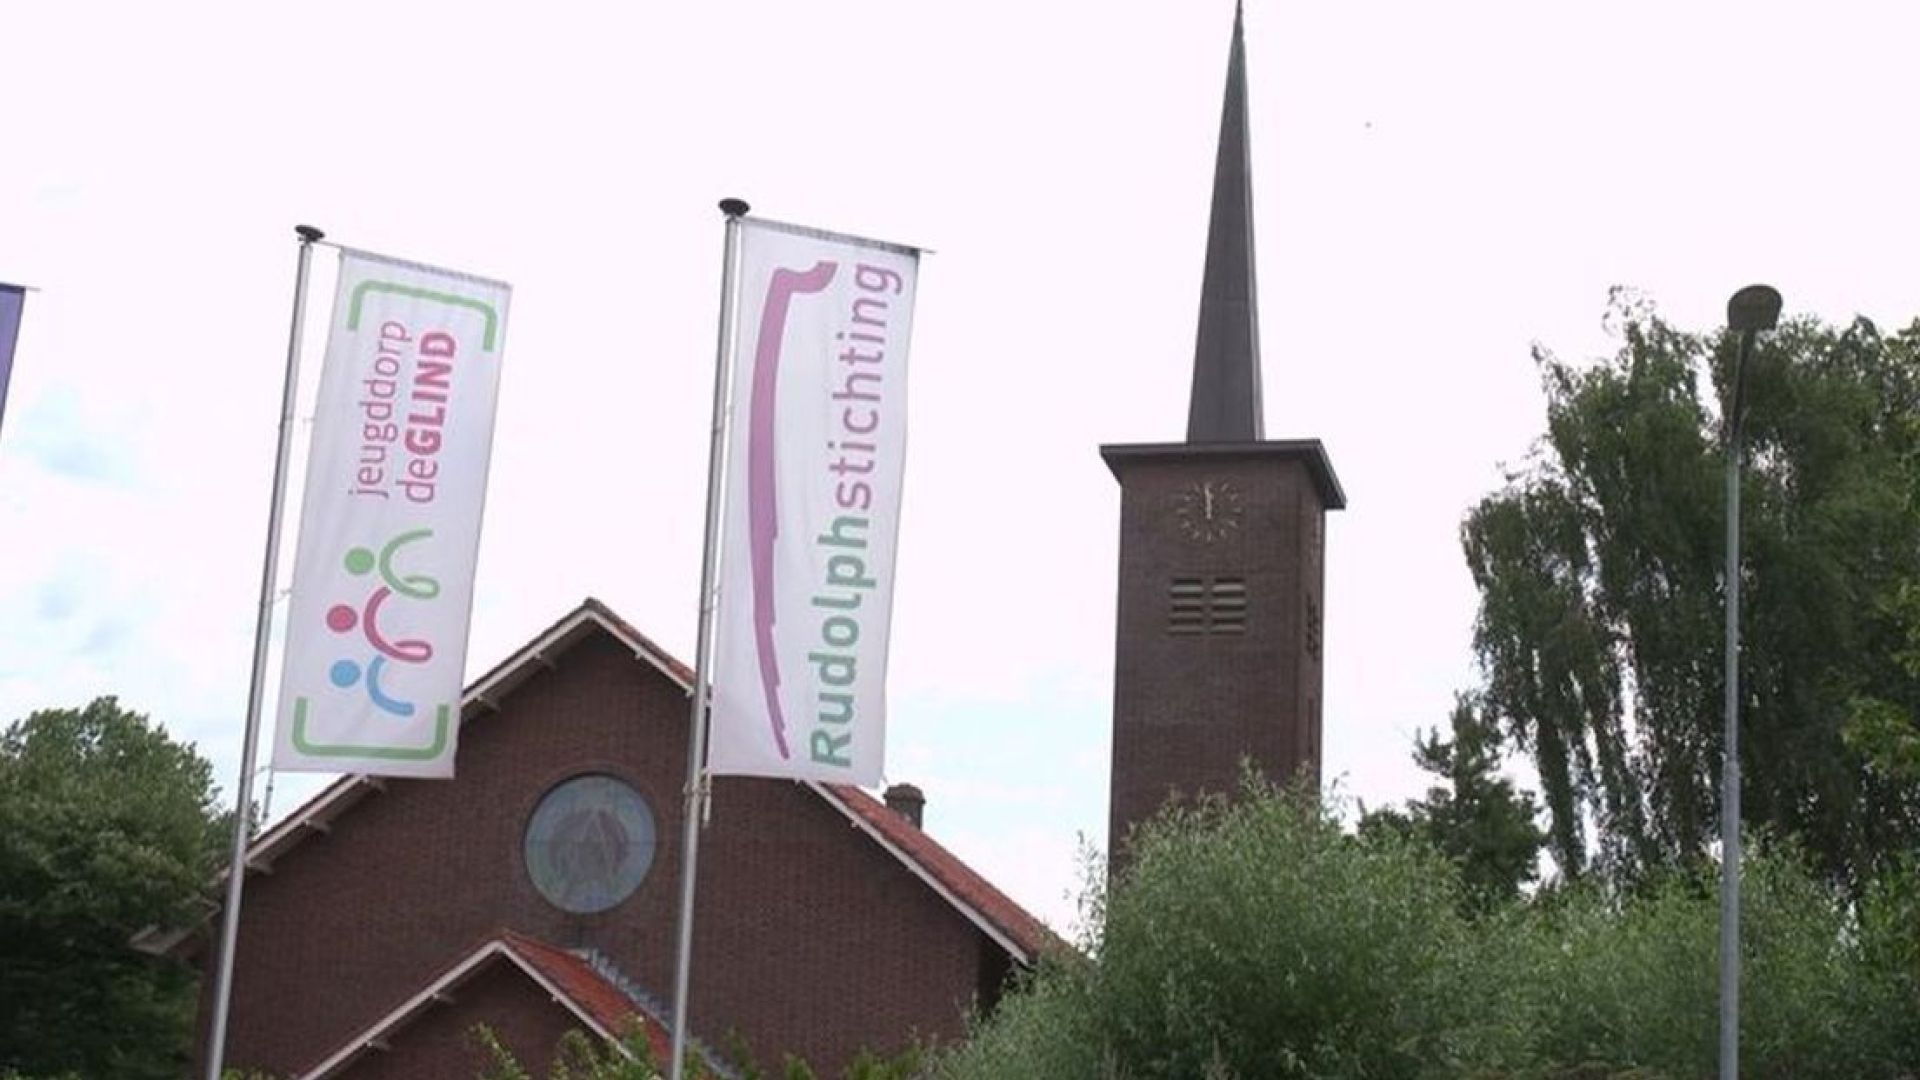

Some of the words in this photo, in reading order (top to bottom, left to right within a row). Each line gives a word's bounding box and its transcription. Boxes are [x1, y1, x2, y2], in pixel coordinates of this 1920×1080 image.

[348, 319, 413, 500] jeugddorp
[396, 330, 458, 504] deGLIND
[808, 262, 903, 767] Rudolphstichting
